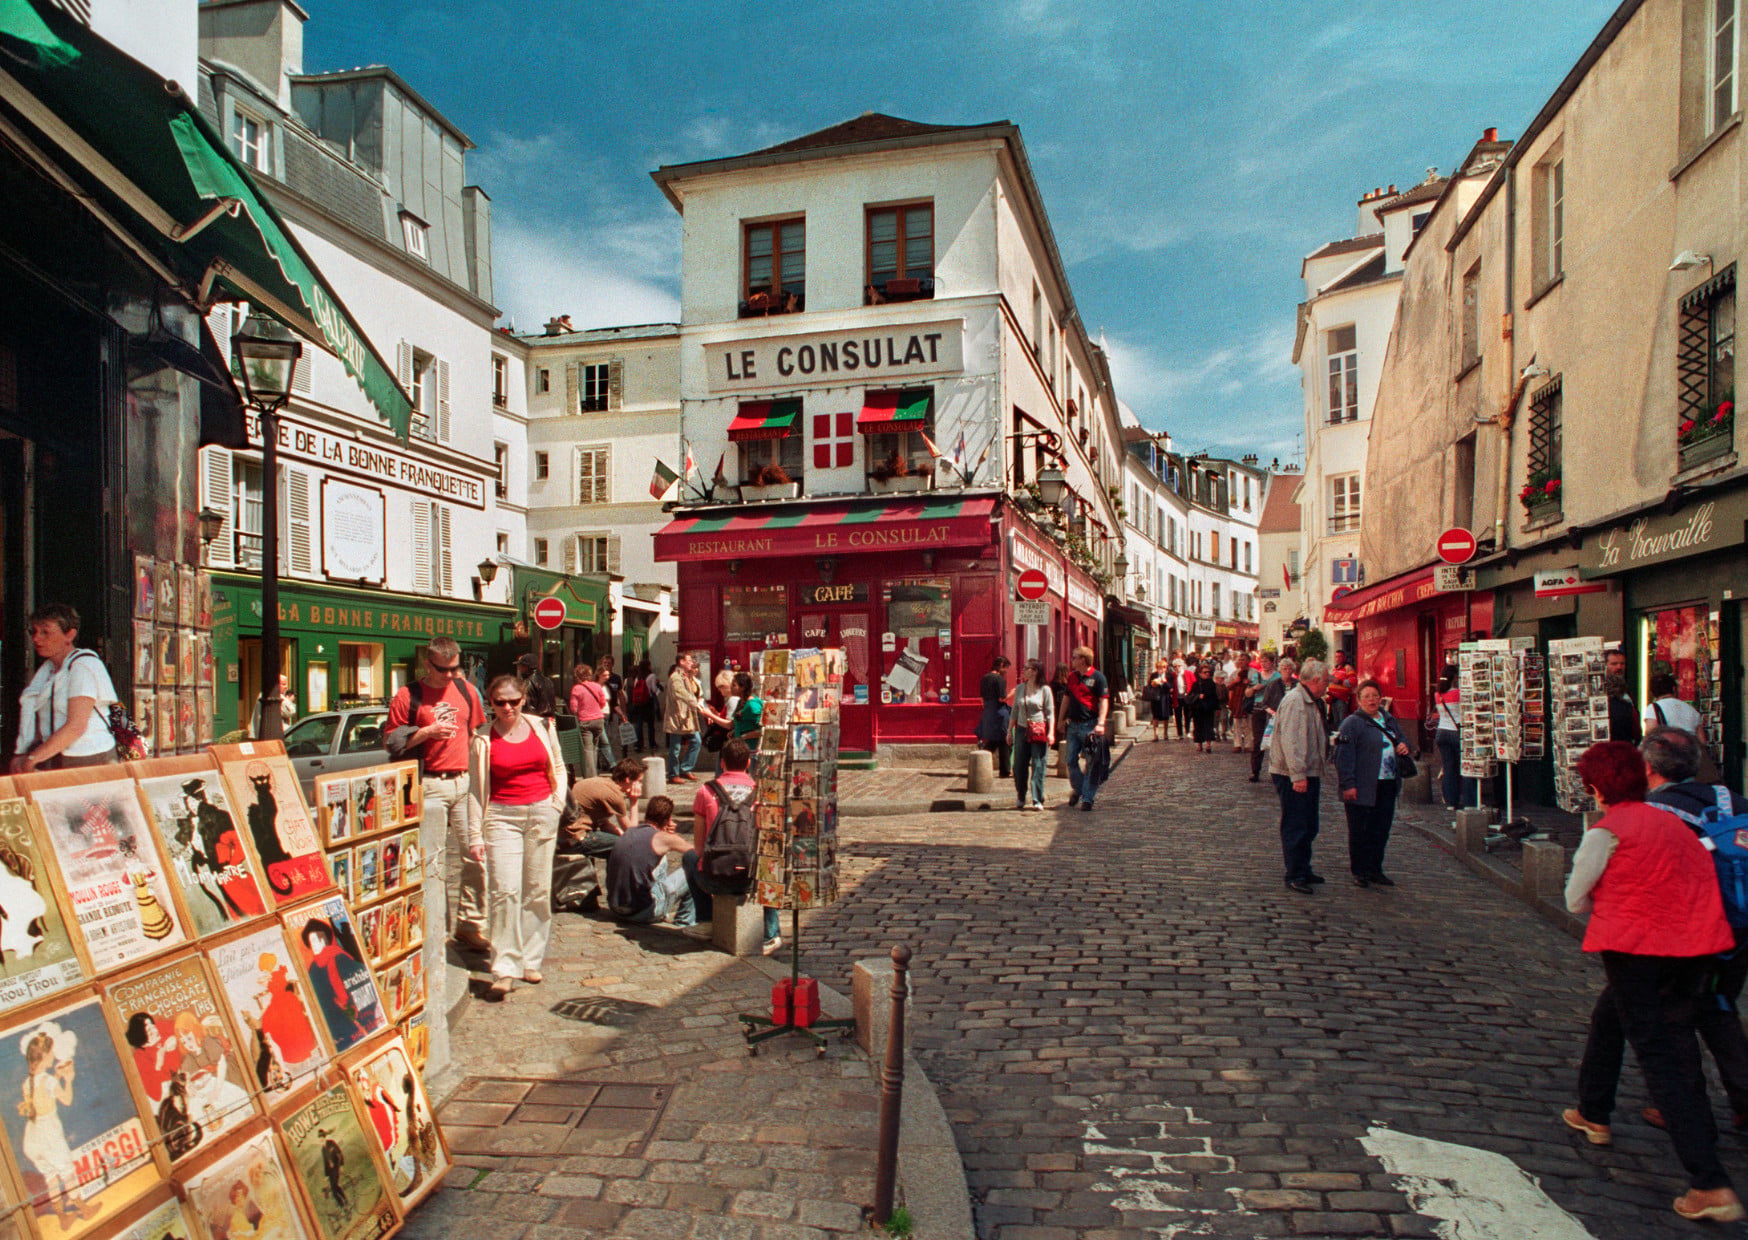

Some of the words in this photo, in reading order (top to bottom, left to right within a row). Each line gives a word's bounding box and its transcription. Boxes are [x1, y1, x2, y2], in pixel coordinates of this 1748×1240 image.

[725, 350, 757, 381] LE
[777, 333, 942, 376] CONSULAT
[295, 429, 317, 454] DE
[322, 437, 344, 463] LA
[349, 446, 397, 478] BONNE
[400, 461, 479, 501] FRANQUETTE
[688, 538, 774, 555] RESTAURANT
[815, 532, 838, 549] LE
[848, 526, 950, 547] CONSULAT
[1599, 528, 1620, 569] La
[1629, 501, 1715, 560] Trouvaille
[1541, 578, 1565, 587] AGFA
[278, 602, 300, 622] LA
[310, 605, 373, 629] BONNE
[380, 612, 485, 638] FRANQUETTE
[172, 863, 248, 890] MONTMARTRE
[114, 967, 183, 1003] COMPAGNIE
[287, 1104, 321, 1147] HOWE
